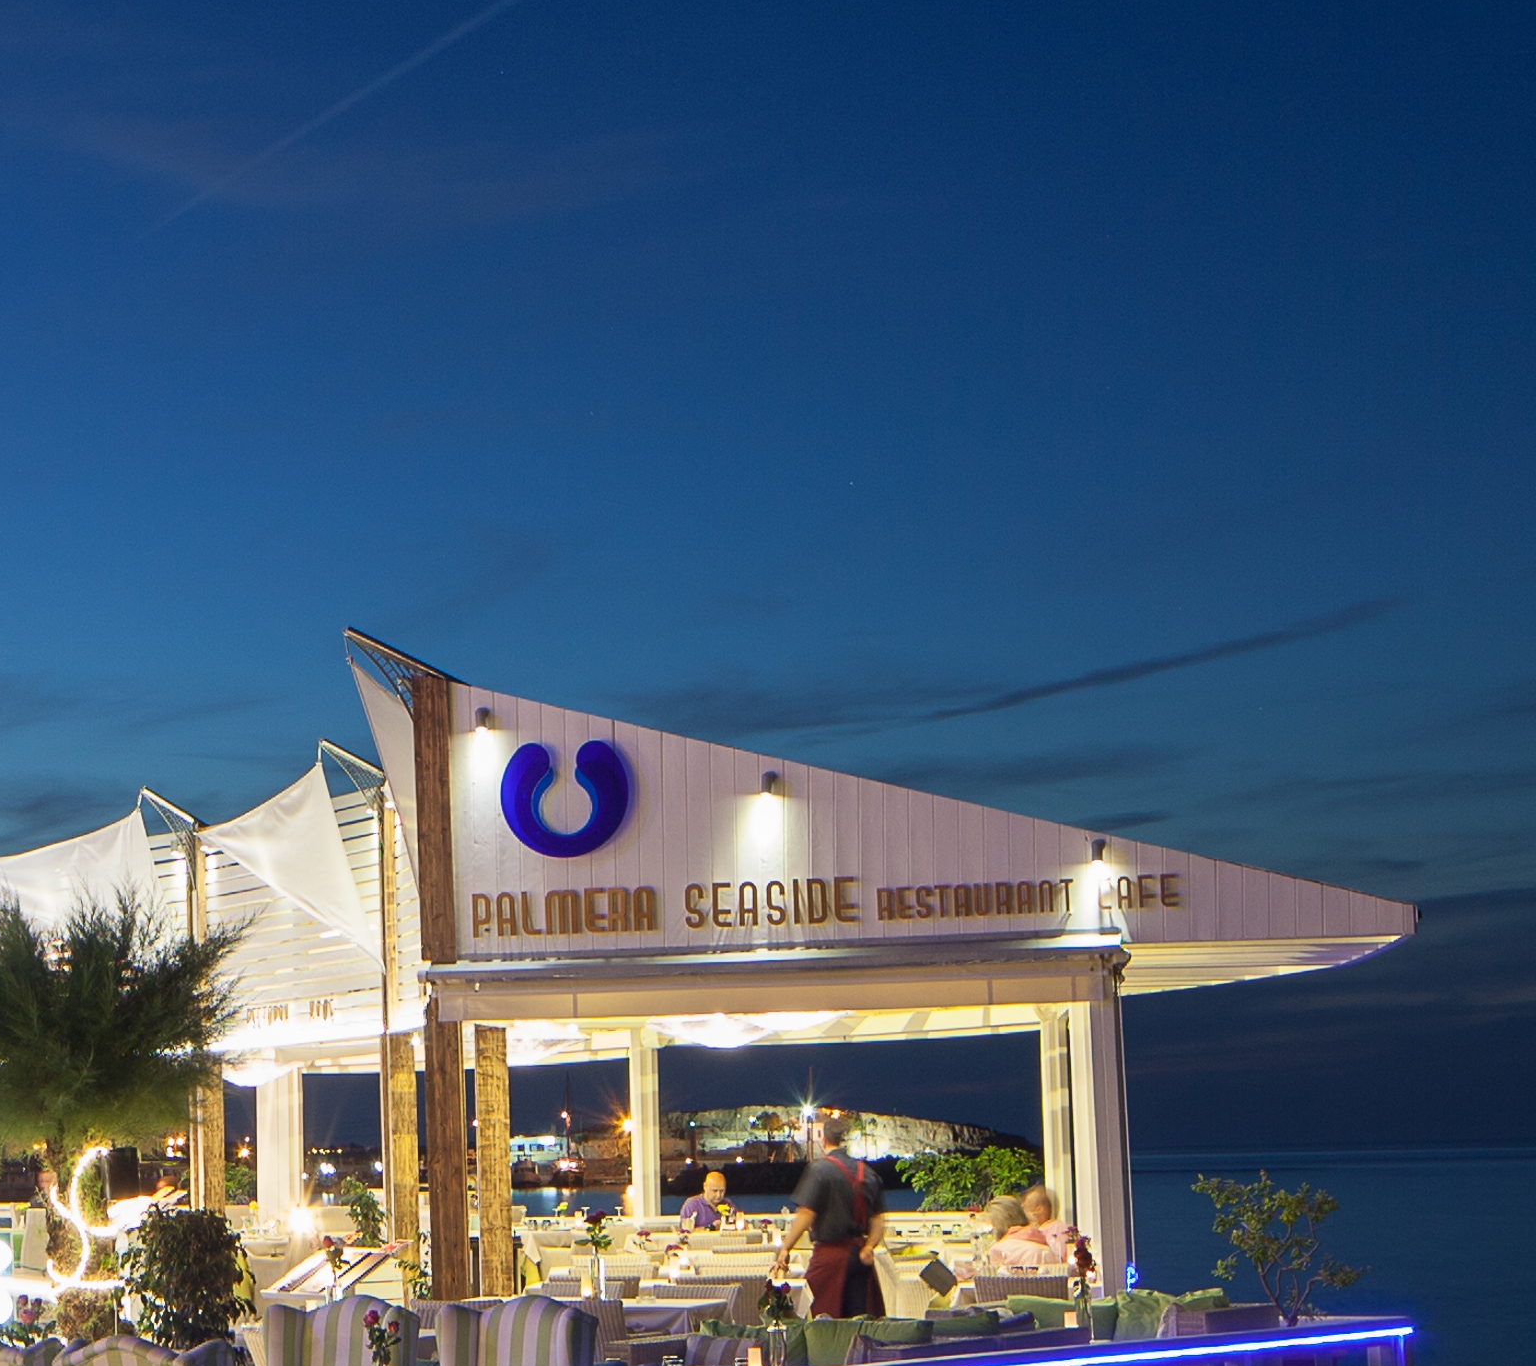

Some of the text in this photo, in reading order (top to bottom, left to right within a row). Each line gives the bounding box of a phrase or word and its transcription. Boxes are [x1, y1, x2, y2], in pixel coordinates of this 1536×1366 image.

[471, 873, 1180, 938] PALMERA SEASIDE RESTAURANT CAFE
